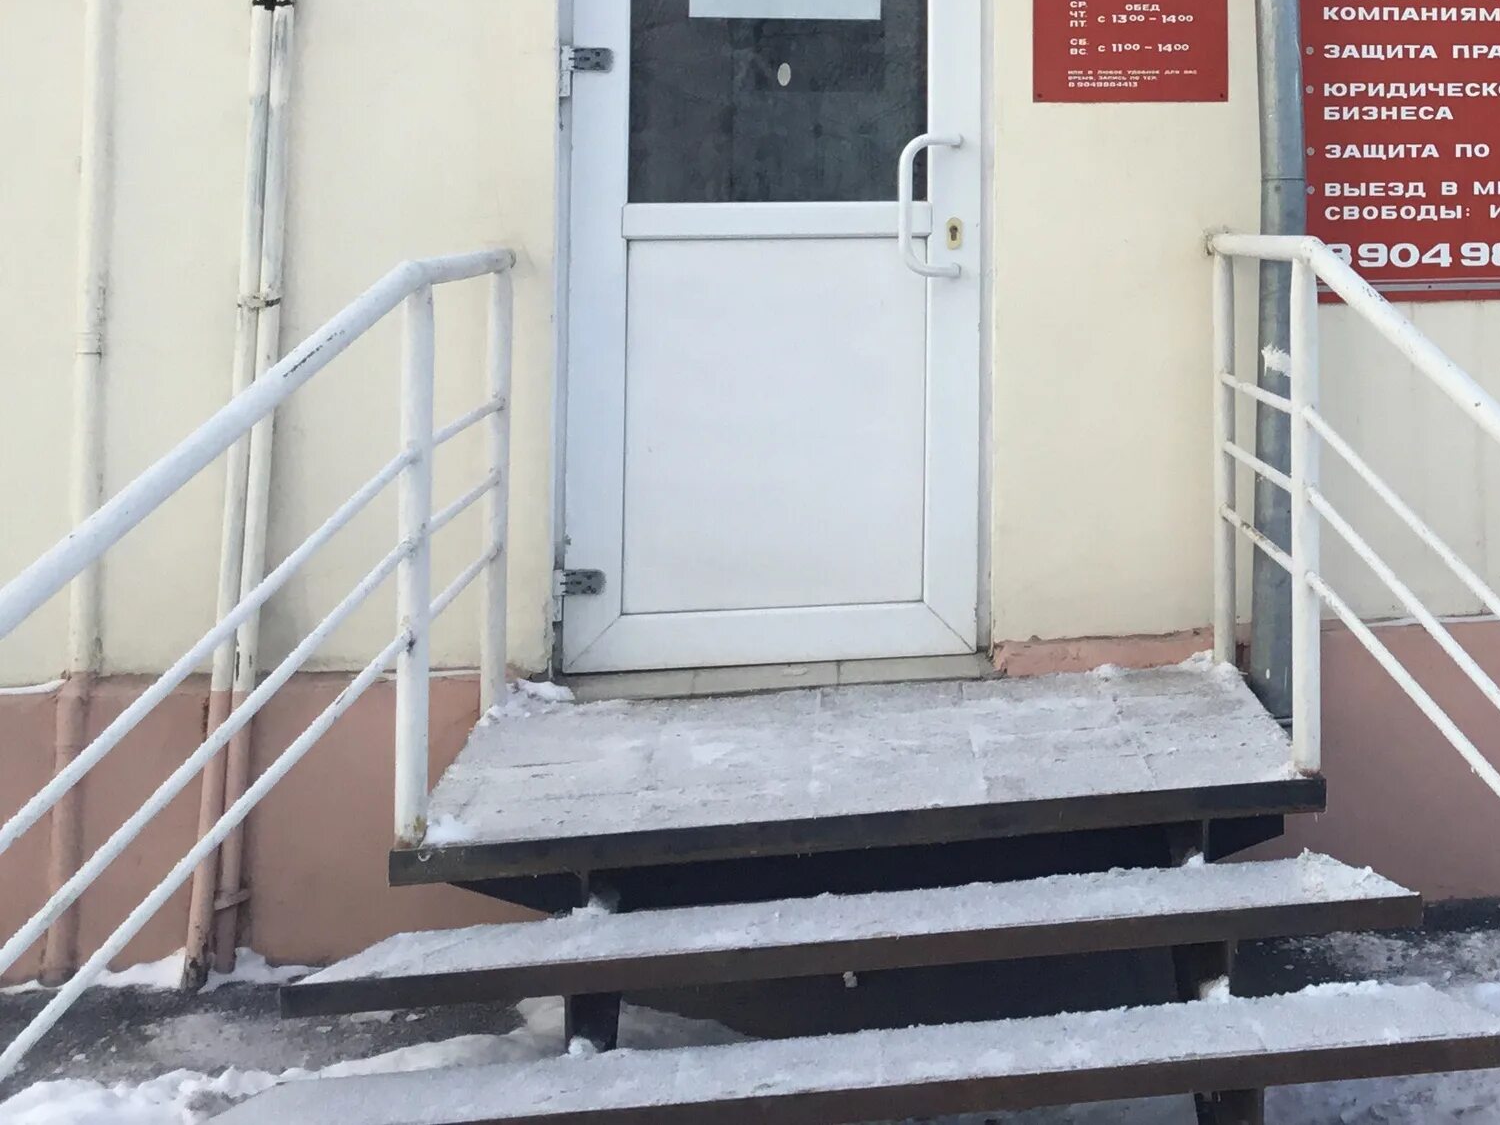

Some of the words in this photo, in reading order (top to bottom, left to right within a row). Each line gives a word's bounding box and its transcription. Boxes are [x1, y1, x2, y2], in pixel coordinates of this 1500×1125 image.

[1324, 45, 1437, 60] ЗАЩИТА
[1324, 106, 1453, 120] БИЗНЕСА
[1325, 144, 1439, 160] ЗАЩИТА
[1456, 144, 1489, 157] ПО
[1325, 182, 1426, 198] ВЫЕЗД
[1442, 182, 1457, 195] В
[1325, 205, 1469, 221] СВОБОДЫ:
[1358, 243, 1452, 267] 904
